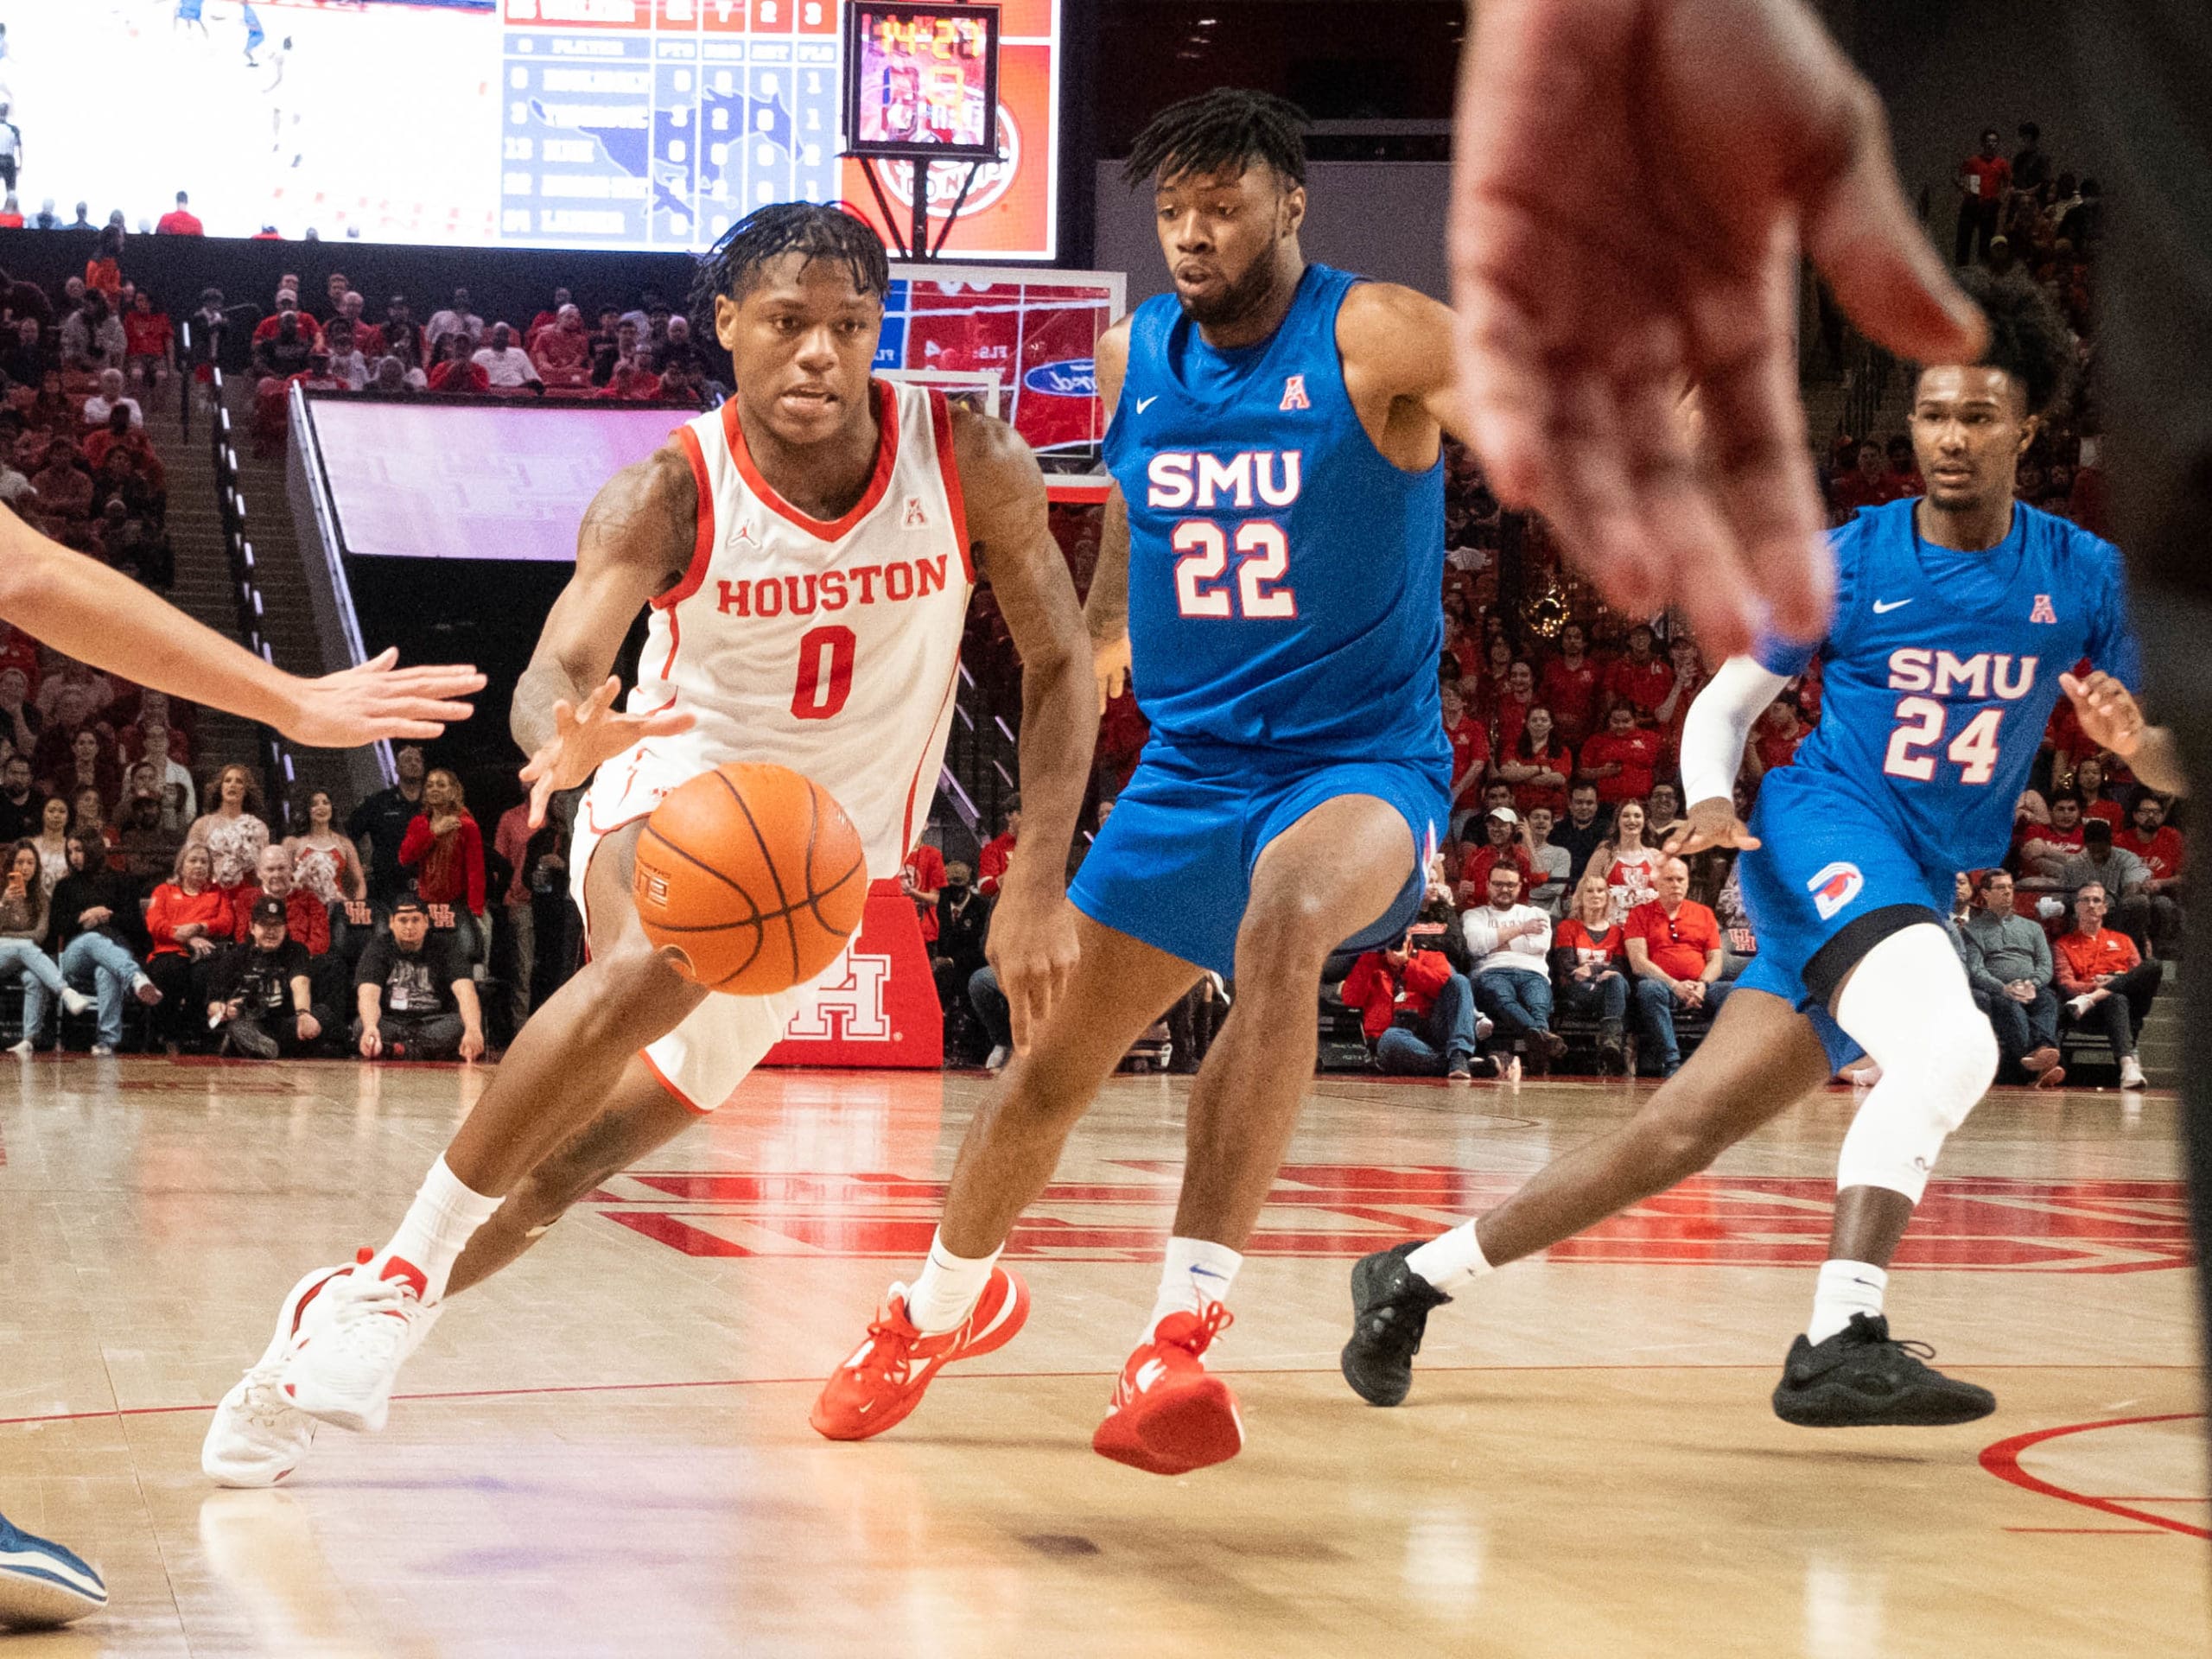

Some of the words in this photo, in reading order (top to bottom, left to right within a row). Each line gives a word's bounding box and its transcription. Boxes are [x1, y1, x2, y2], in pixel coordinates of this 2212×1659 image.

[1147, 450, 1301, 508] SMU
[716, 554, 948, 617] HOUSTON
[1171, 518, 1299, 620] 22
[790, 625, 856, 720] 0
[1888, 647, 2038, 701] SMU
[1883, 696, 2005, 785] 24
